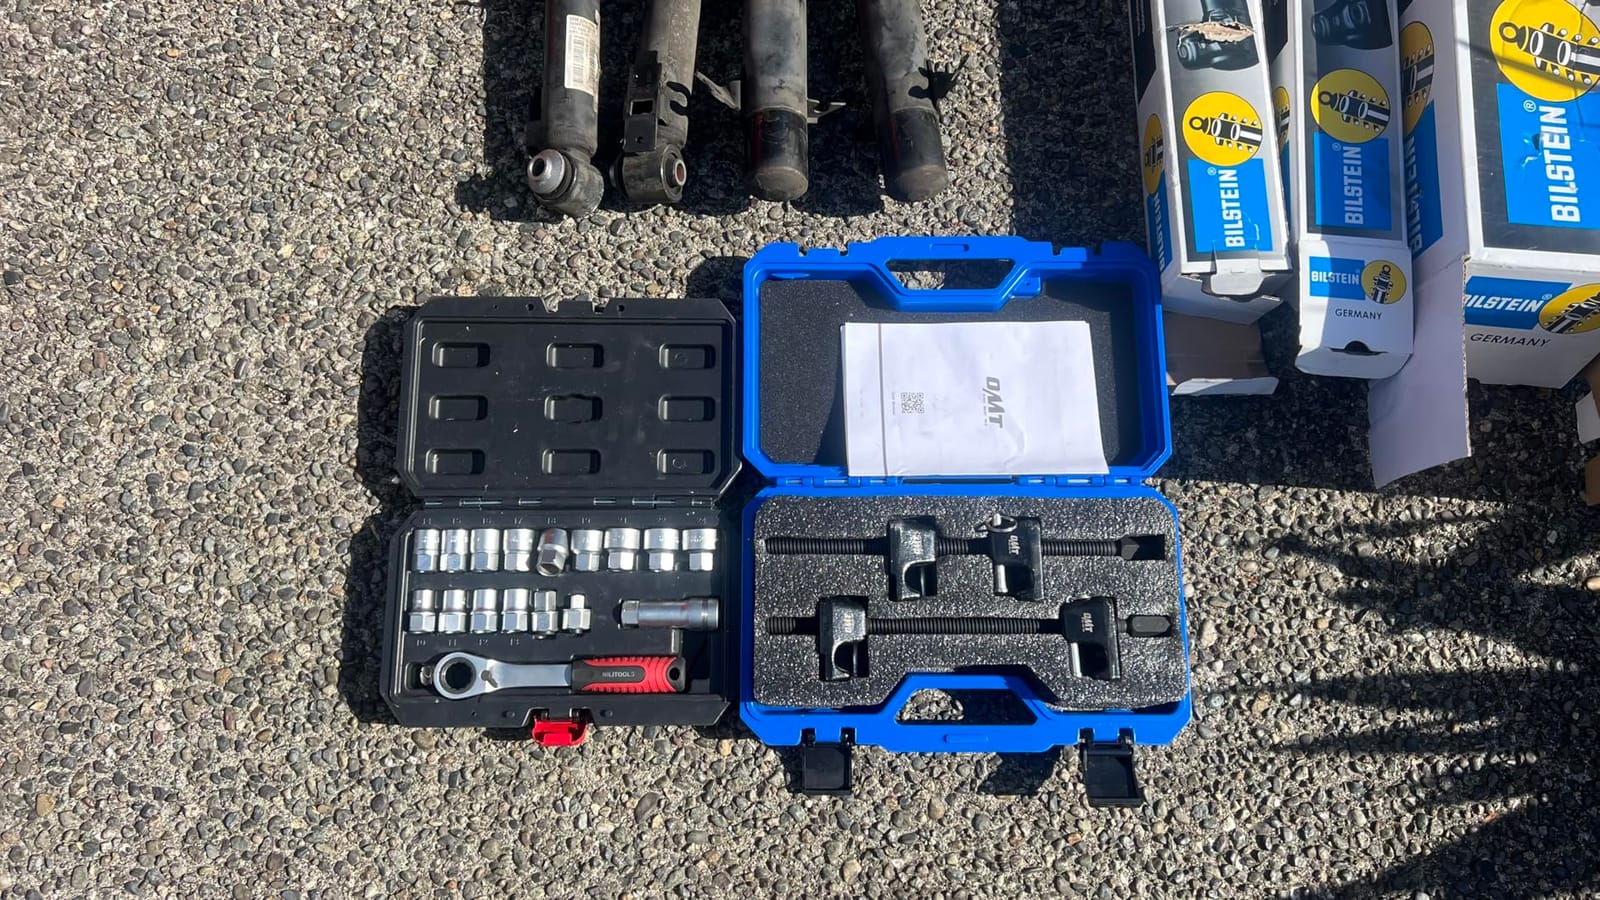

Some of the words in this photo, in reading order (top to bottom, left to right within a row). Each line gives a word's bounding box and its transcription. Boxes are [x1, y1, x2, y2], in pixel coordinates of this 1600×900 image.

[1342, 145, 1364, 225] BILSTEIN
[1538, 105, 1581, 222] BILSTEIN
[1218, 169, 1246, 248] BILSTEIN
[1311, 270, 1360, 285] BILSTEIN
[1335, 308, 1383, 320] GERMANY
[1470, 333, 1552, 347] GERMANY
